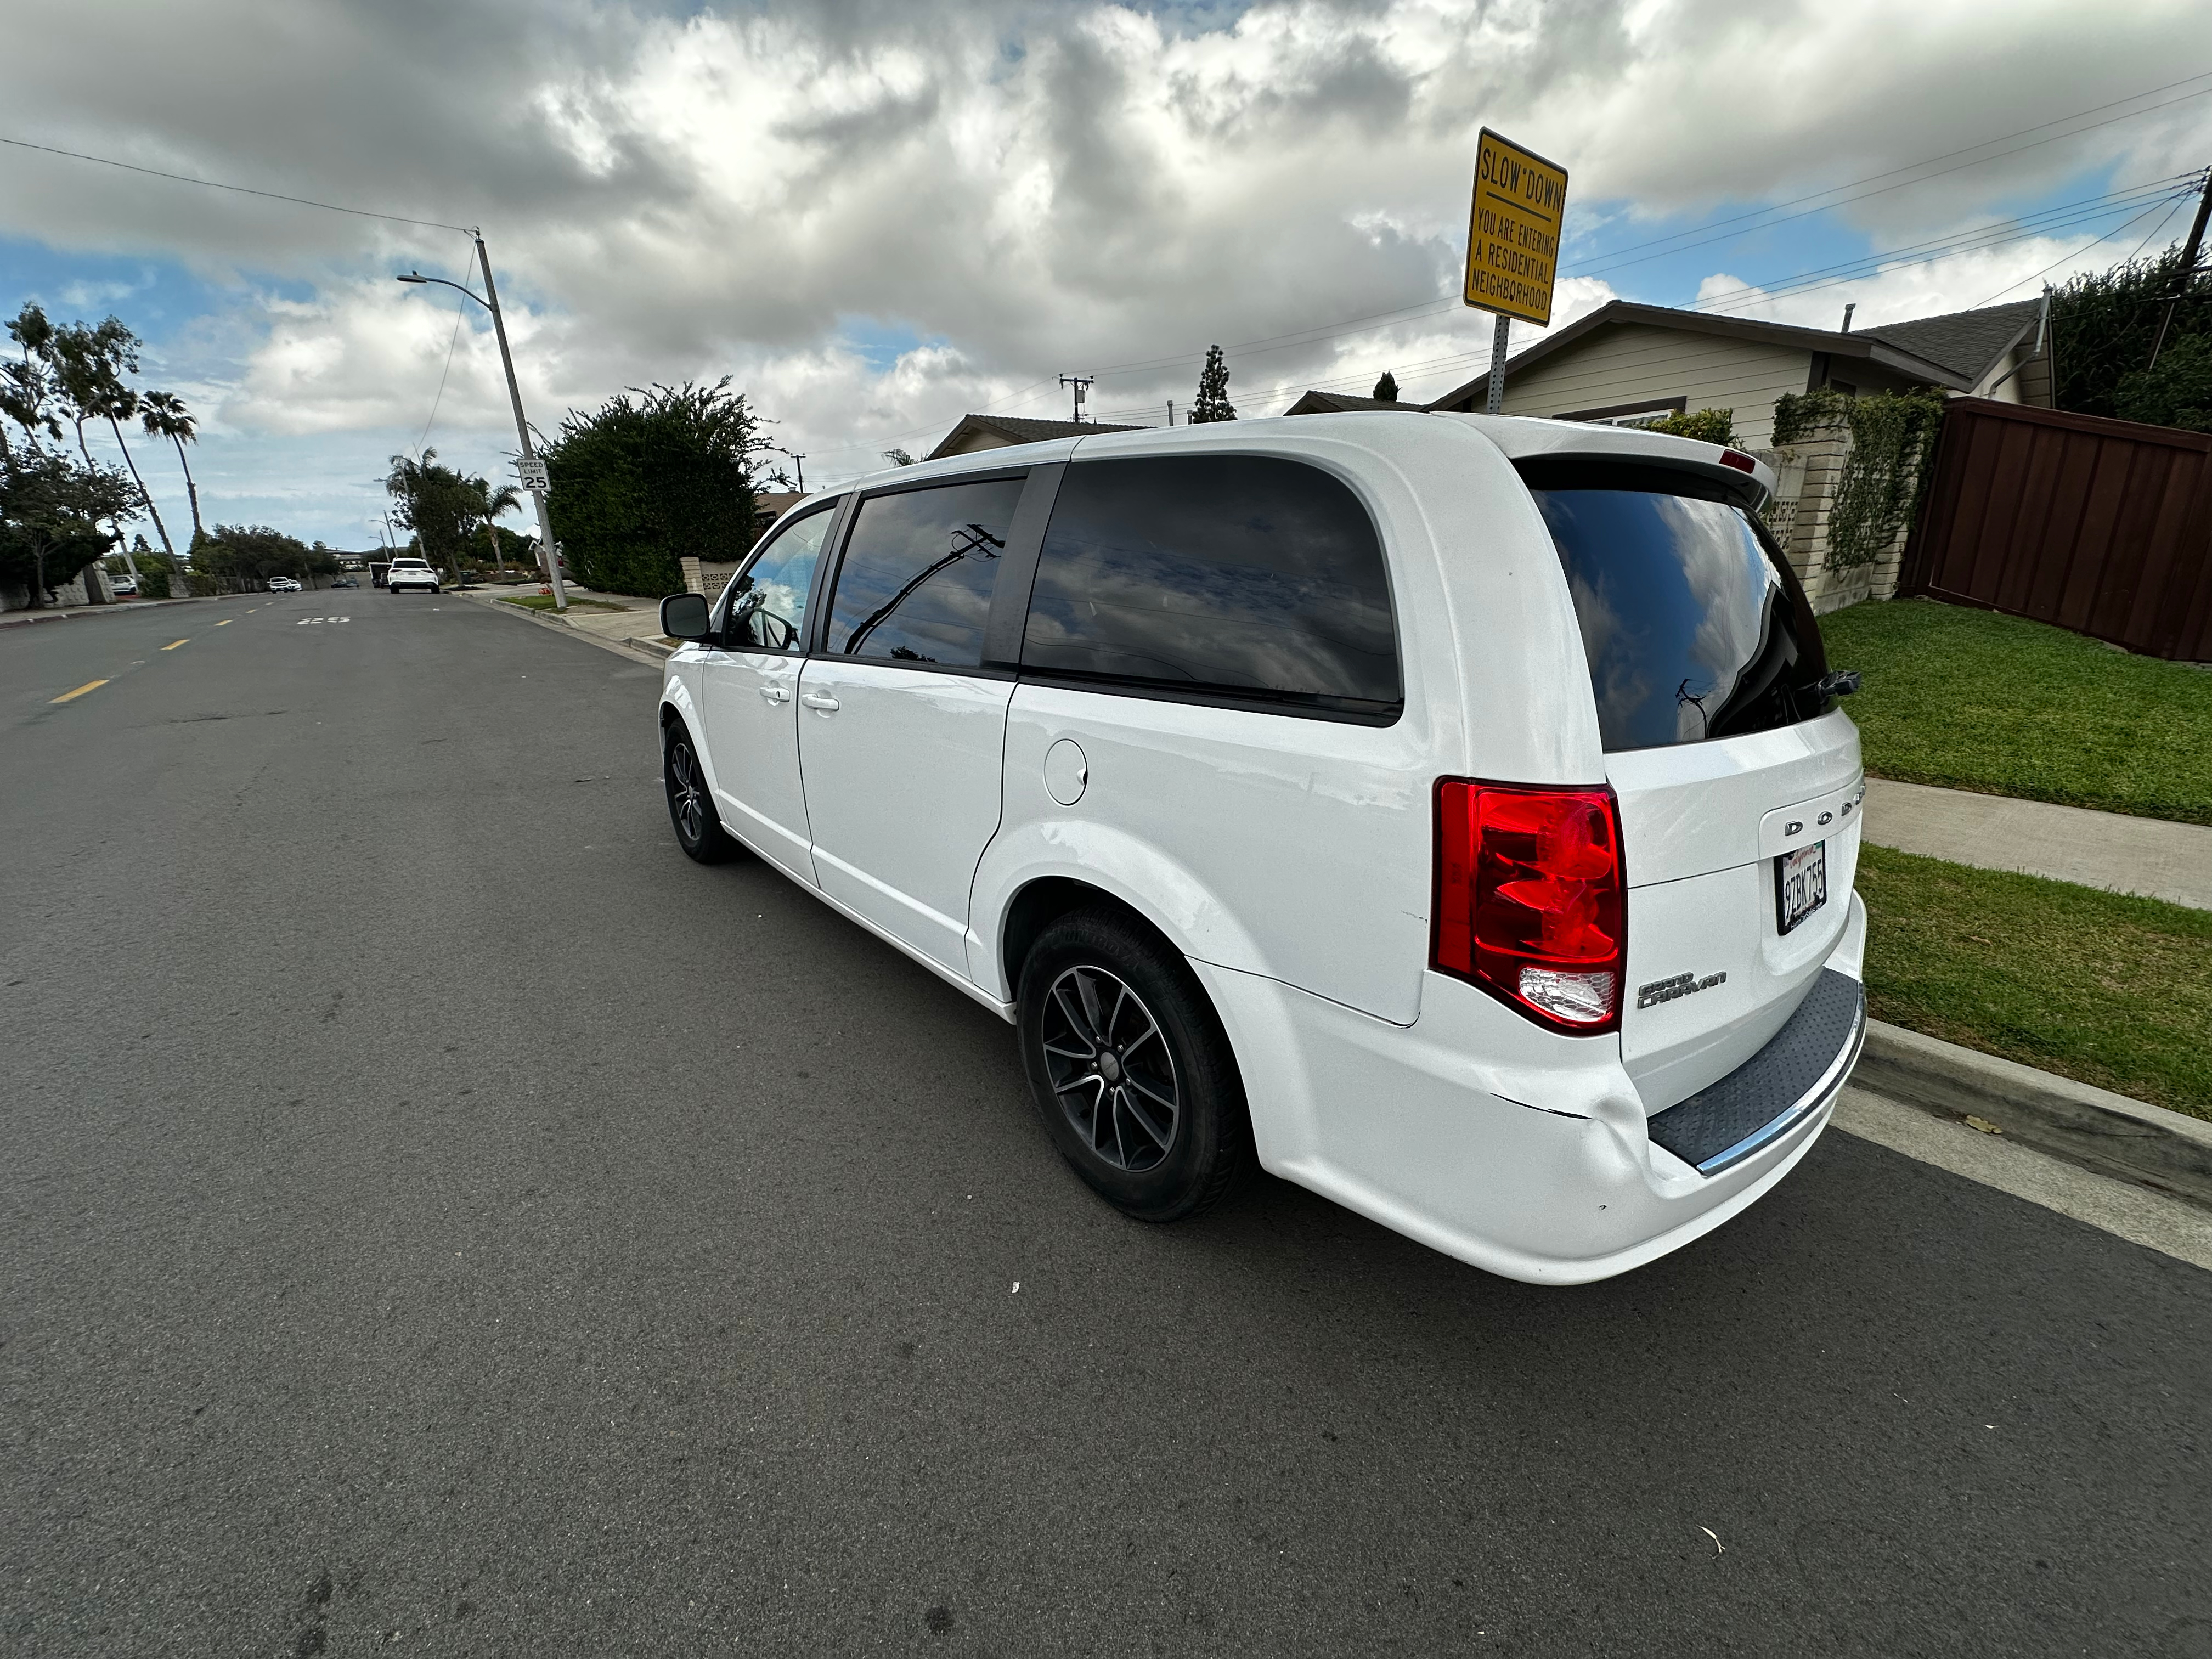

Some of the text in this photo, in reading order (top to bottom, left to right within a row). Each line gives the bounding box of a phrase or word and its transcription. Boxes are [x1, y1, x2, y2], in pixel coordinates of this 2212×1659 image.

[1481, 148, 1562, 212] SLOW DOWN
[1478, 207, 1554, 258] YOU ARE ENTERING
[1475, 238, 1548, 284] A RESIDENTIAL
[1472, 267, 1547, 311] NEIGHBORHOOD
[524, 476, 546, 488] 25
[1637, 971, 1727, 1009] CARAVAN
[1639, 972, 1694, 996] GRAND
